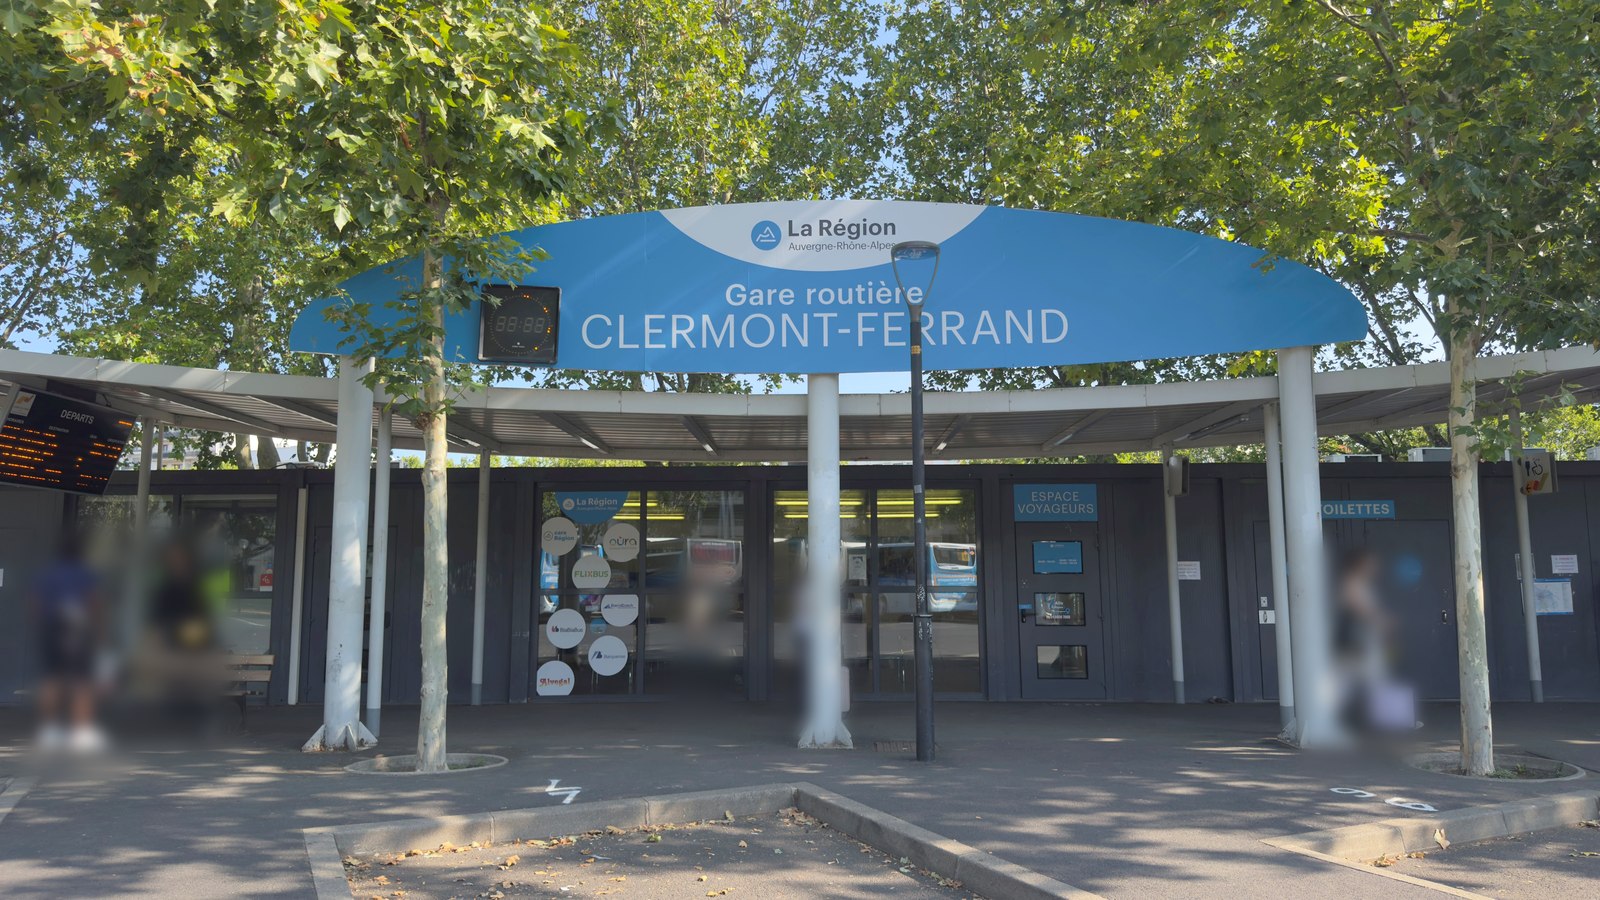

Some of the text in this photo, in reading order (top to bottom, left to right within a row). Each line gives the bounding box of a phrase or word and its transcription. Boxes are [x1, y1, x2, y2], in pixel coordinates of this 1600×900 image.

[788, 218, 896, 240] La Région
[788, 240, 896, 253] Auvergne-Rhône-Alpes
[725, 281, 924, 306] Gare routière
[581, 308, 1069, 350] CLERMONT-FERRAND
[60, 409, 95, 425] DEPARTS
[576, 497, 618, 507] La Région
[1031, 491, 1079, 502] ESPACE
[1018, 503, 1095, 514] VOYAGEURS
[574, 570, 609, 578] FLIXBUS
